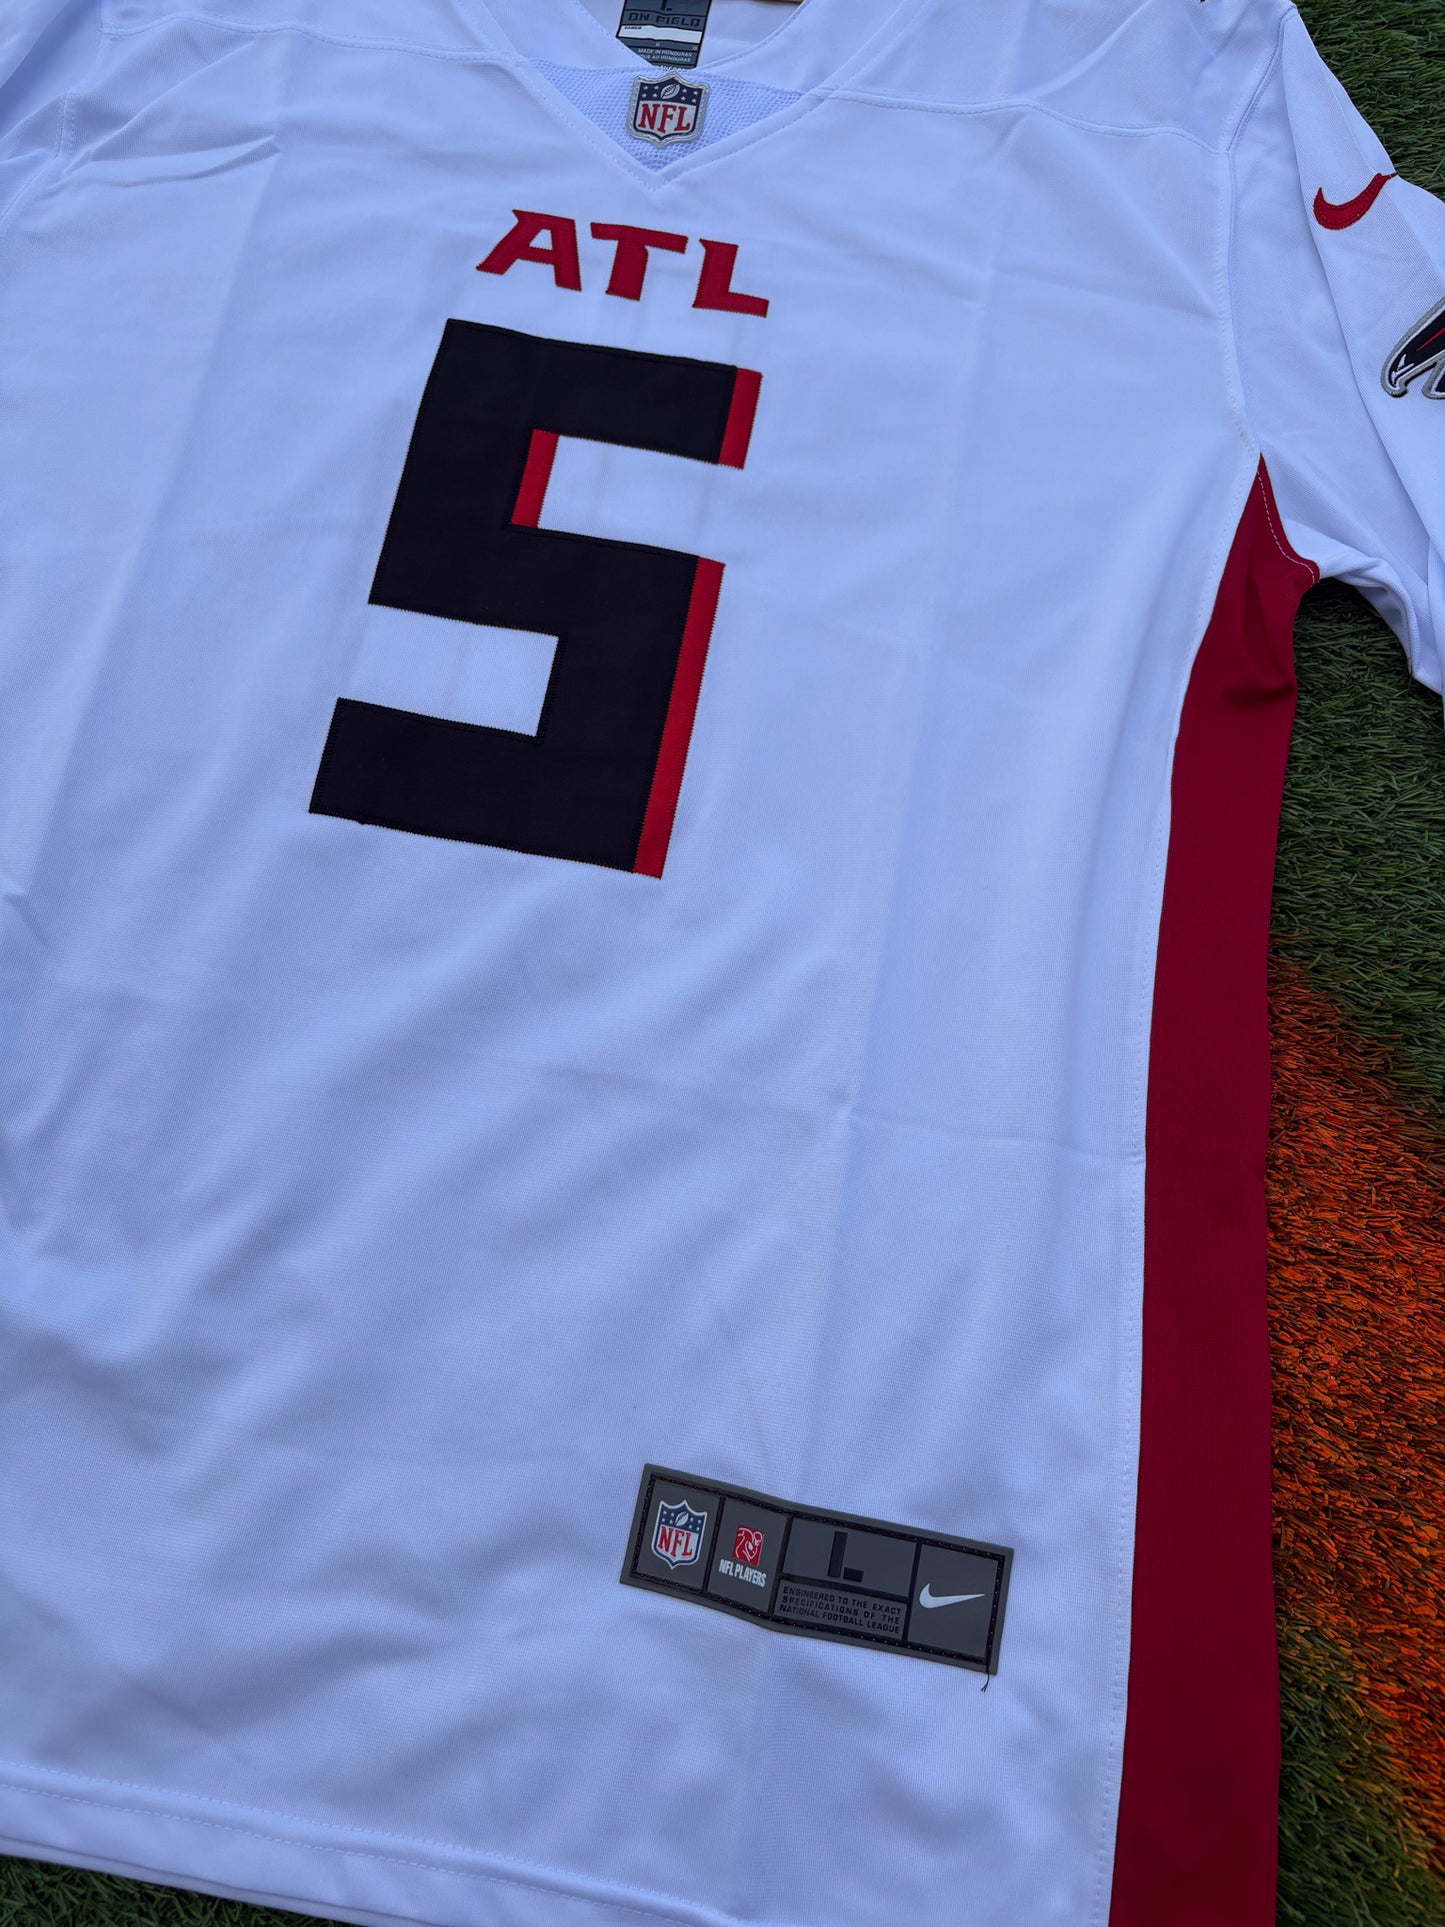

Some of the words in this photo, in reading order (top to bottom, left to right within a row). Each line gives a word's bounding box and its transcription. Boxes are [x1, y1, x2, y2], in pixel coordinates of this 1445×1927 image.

[628, 12, 650, 22] ON
[655, 15, 700, 27] FIELD
[638, 103, 691, 134] NFL
[475, 208, 769, 318] ATL
[308, 317, 764, 880] 5
[657, 1525, 693, 1558] NFL
[827, 1530, 864, 1583] L
[719, 1558, 735, 1577] NFL
[734, 1564, 767, 1588] PLAYERS
[782, 1595, 859, 1616] SPECIFICATIONS
[863, 1610, 876, 1619] OF
[882, 1614, 901, 1625] THE
[783, 1586, 836, 1603] ENGINEERED
[838, 1596, 848, 1605] TO
[852, 1599, 868, 1609] THE
[872, 1603, 902, 1615] EXACT
[779, 1604, 820, 1618] NATIONAL
[822, 1611, 864, 1627] FOOTBALL
[867, 1621, 901, 1634] LEAGUE
